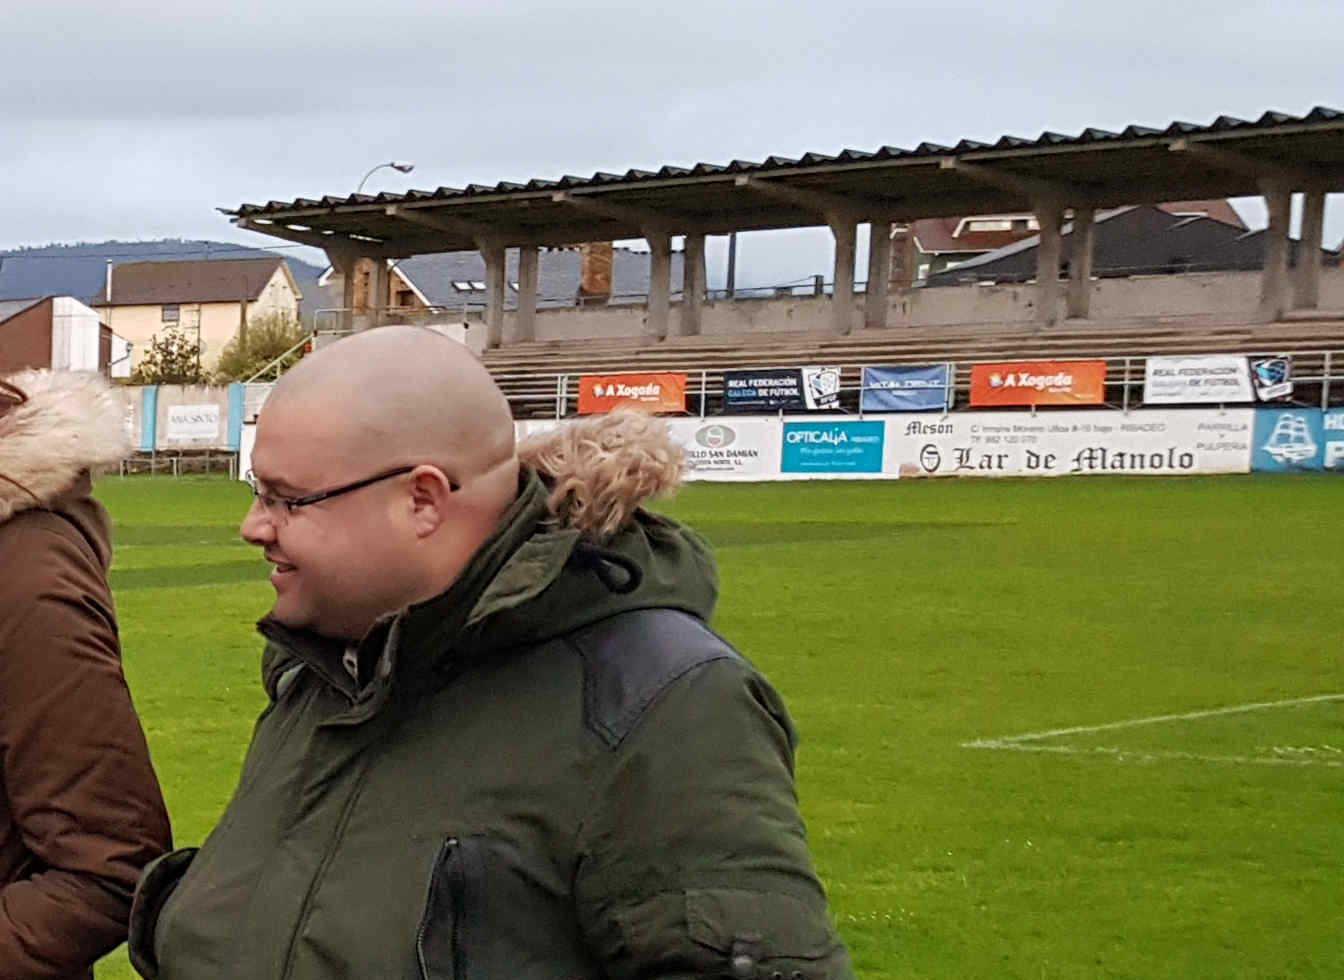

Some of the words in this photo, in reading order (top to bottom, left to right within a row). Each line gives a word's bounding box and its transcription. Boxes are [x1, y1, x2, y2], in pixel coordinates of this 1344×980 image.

[728, 378, 747, 387] REAL
[748, 376, 797, 387] FEDERACIÓN
[1004, 374, 1016, 387] A
[1018, 372, 1072, 391] Xogada
[605, 384, 616, 397] A
[617, 382, 661, 400] Xogada
[758, 388, 769, 397] DE
[770, 386, 800, 396] FÚTBOL
[708, 448, 724, 458] SAN
[952, 447, 1009, 471] Lar
[1025, 449, 1057, 470] de
[1070, 446, 1194, 472] Manolo
